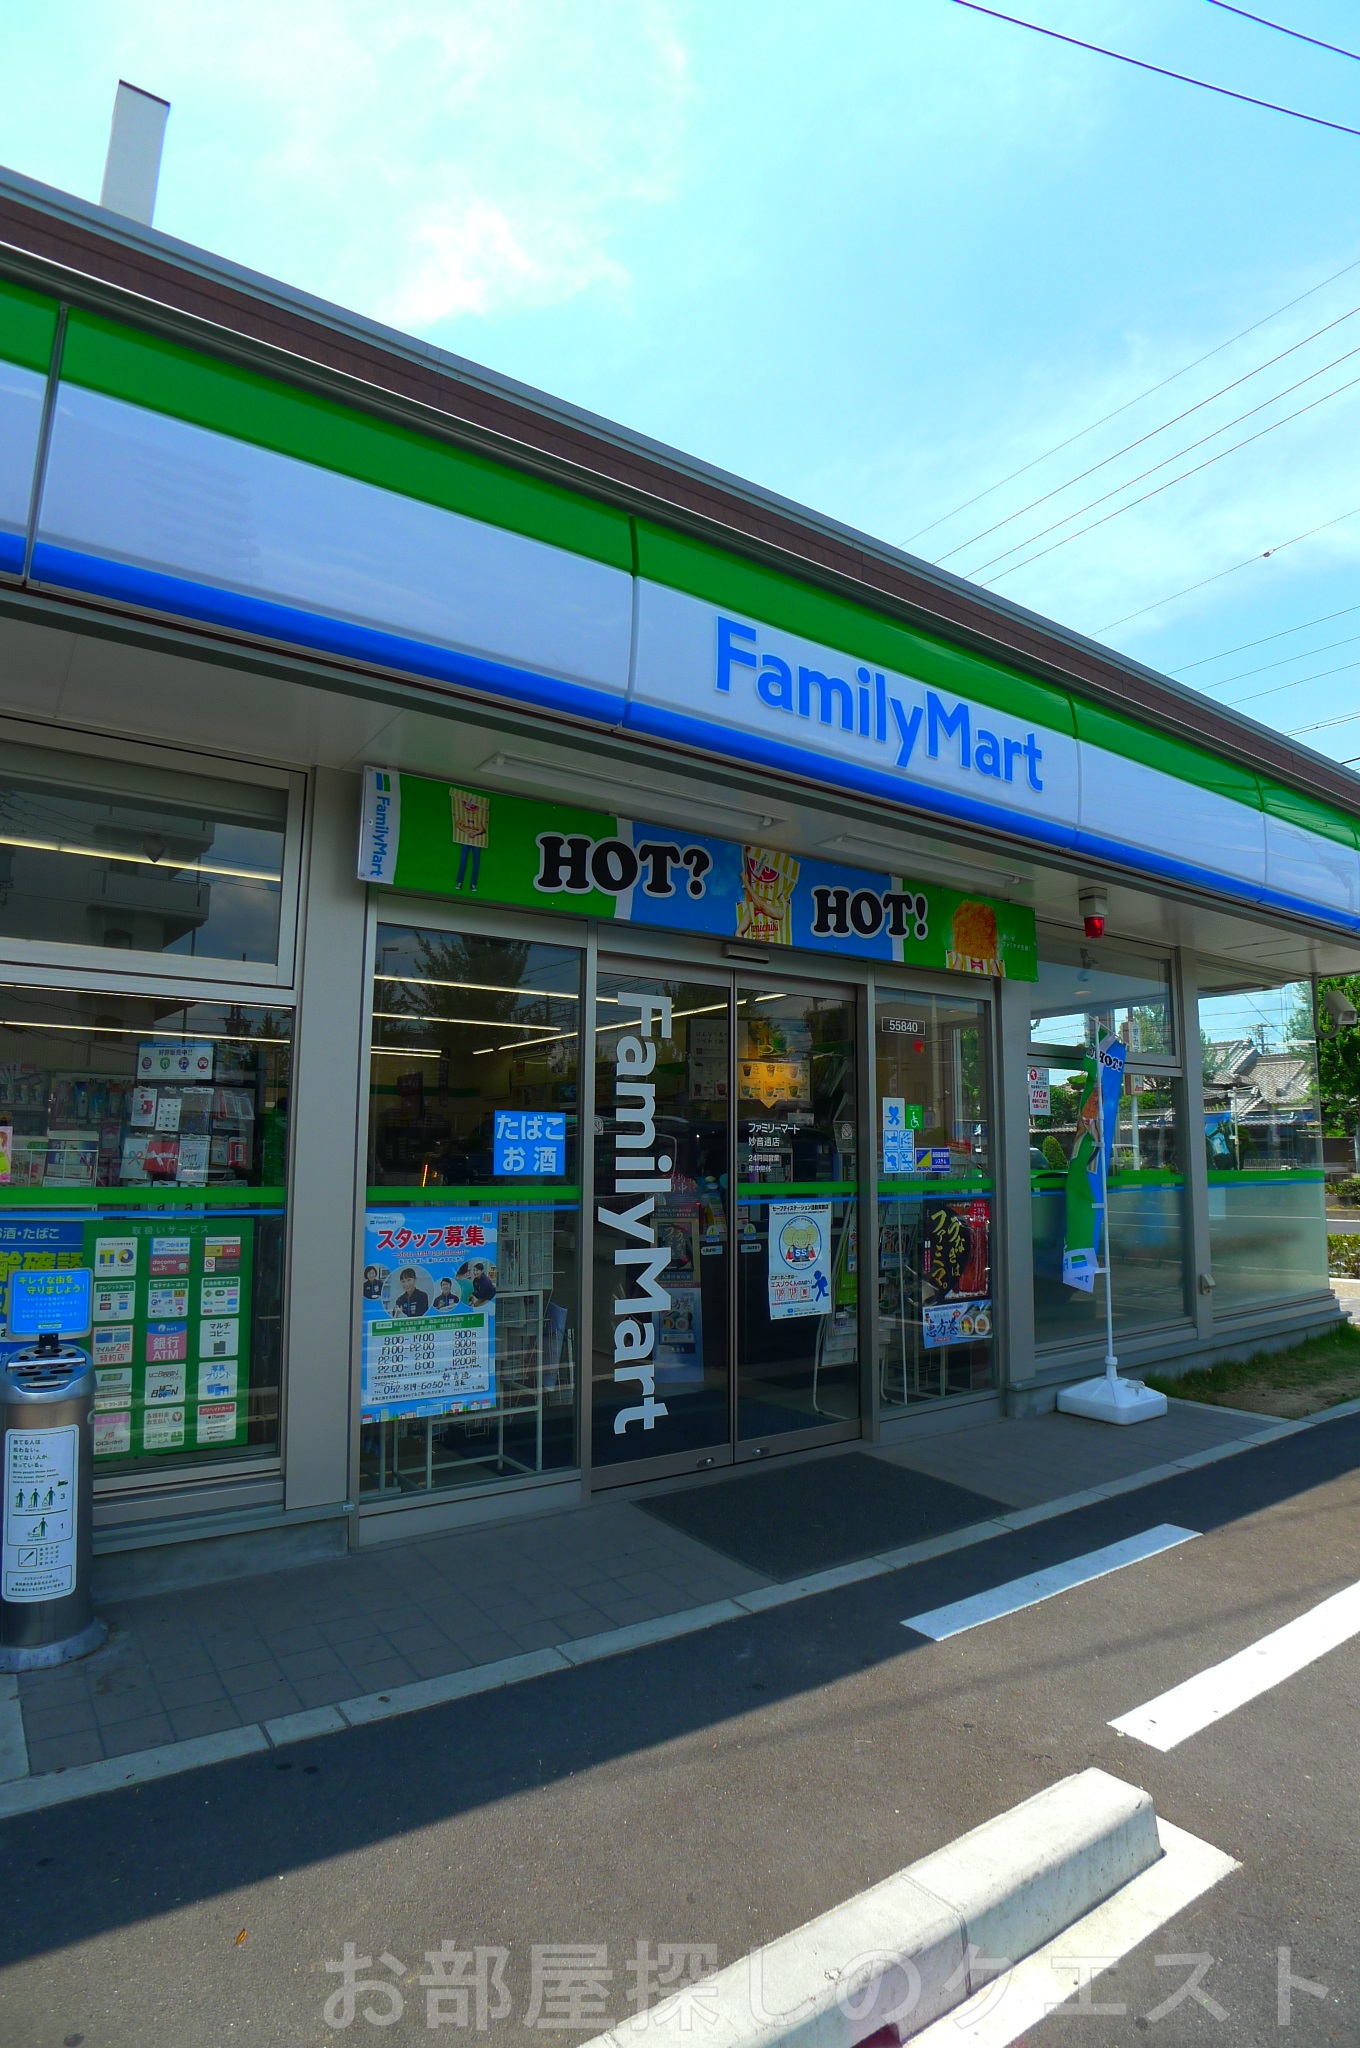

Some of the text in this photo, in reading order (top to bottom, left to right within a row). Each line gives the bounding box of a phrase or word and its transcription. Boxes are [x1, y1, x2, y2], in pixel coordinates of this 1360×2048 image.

[715, 615, 1043, 792] FamilyMart
[370, 796, 391, 876] FamilyMart
[536, 834, 711, 897] HOT?
[812, 887, 928, 938] HOT!
[889, 1020, 918, 1033] 55840
[497, 1114, 564, 1140] たばこ
[748, 1123, 800, 1134] ファミリーマート
[748, 1136, 780, 1147] 妙音通店
[502, 1146, 557, 1173] お酒
[748, 1154, 780, 1162] 24時間営業
[748, 1165, 772, 1173] 年中無休
[598, 992, 672, 1434] FamilyMart
[0, 1227, 60, 1240] 酒・たばこ
[132, 1225, 209, 1234] 取扱いサービス
[377, 1225, 485, 1249] スタッフ募集
[795, 1249, 807, 1257] SS
[931, 1209, 948, 1290] ファミマ。
[947, 1216, 966, 1278] うなぎは
[19, 1275, 74, 1285] キレイな街を
[27, 1284, 85, 1295] 守りましょう!
[454, 1330, 477, 1339] 900円
[926, 1318, 959, 1338] 恵方巻
[153, 1336, 180, 1349] 銀行
[454, 1339, 477, 1348] 900円
[100, 1354, 125, 1362] 特約店
[153, 1350, 179, 1360] ATM
[414, 1351, 435, 1360] 2:00
[452, 1347, 477, 1357] 1200円
[414, 1361, 435, 1370] 6:00
[205, 1372, 231, 1380] プリント
